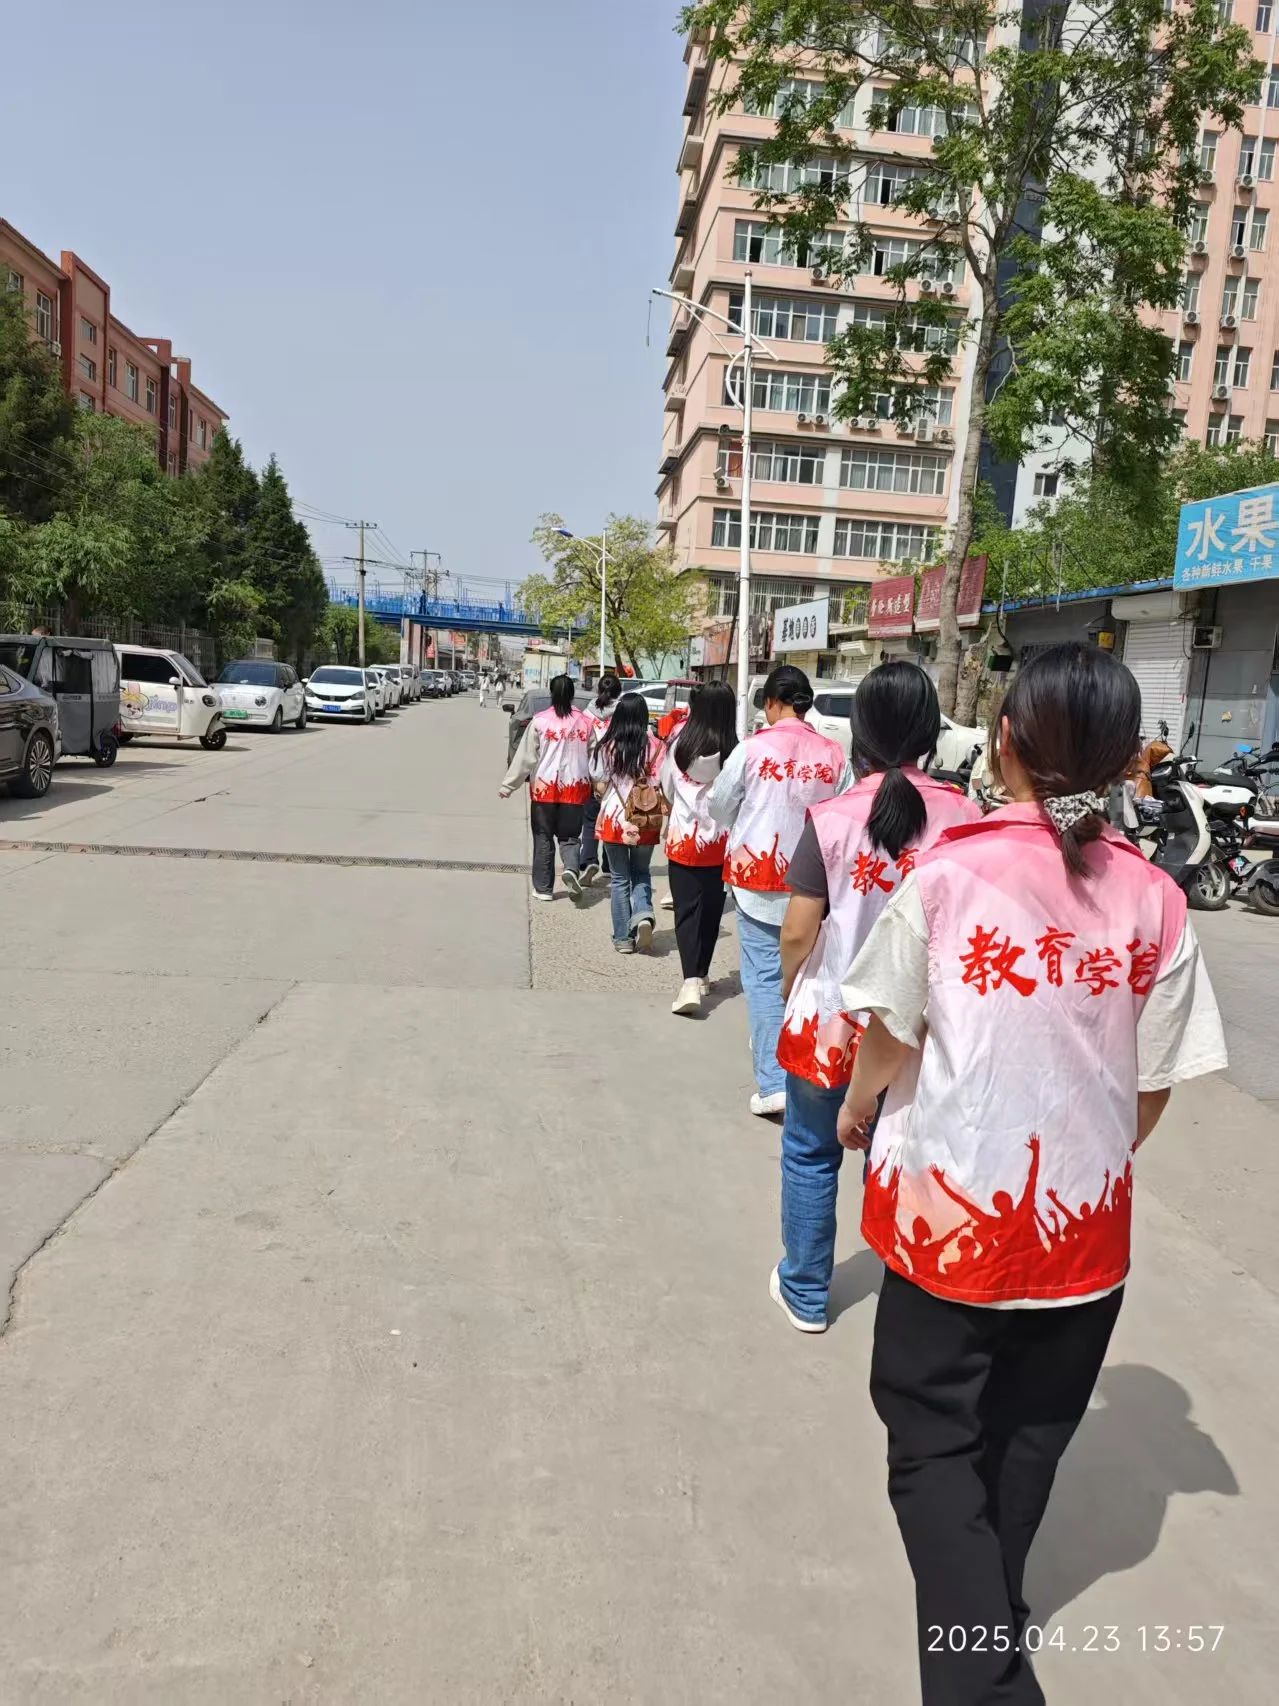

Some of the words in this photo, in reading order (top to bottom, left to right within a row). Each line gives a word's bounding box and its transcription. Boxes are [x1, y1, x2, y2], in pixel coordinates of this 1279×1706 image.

[1185, 494, 1278, 561] 水果
[1182, 559, 1243, 581] 各种新鲜水果
[545, 727, 588, 742] 教育学院
[759, 756, 833, 783] 教育学院
[959, 925, 1159, 996] 教育学院
